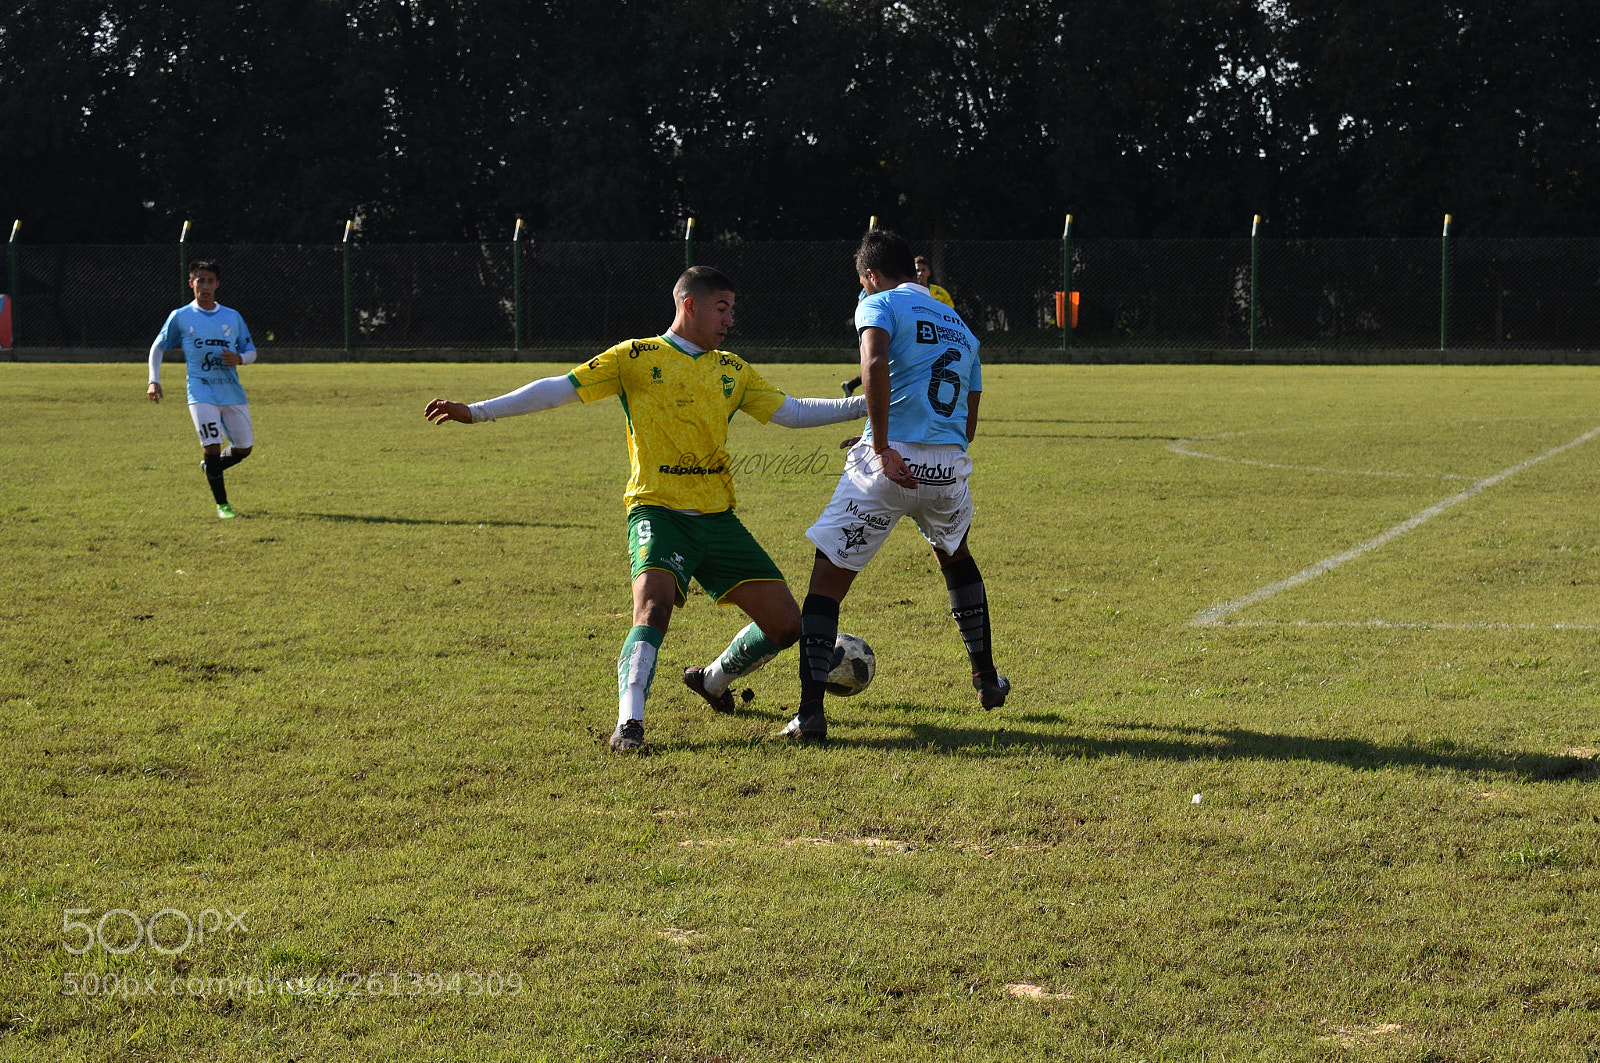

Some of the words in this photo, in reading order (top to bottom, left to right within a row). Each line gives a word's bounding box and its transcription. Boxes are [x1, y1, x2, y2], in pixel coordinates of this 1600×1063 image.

[928, 347, 962, 418] 6
[201, 422, 219, 439] 15
[637, 520, 652, 546] 9
[952, 607, 983, 619] LYON
